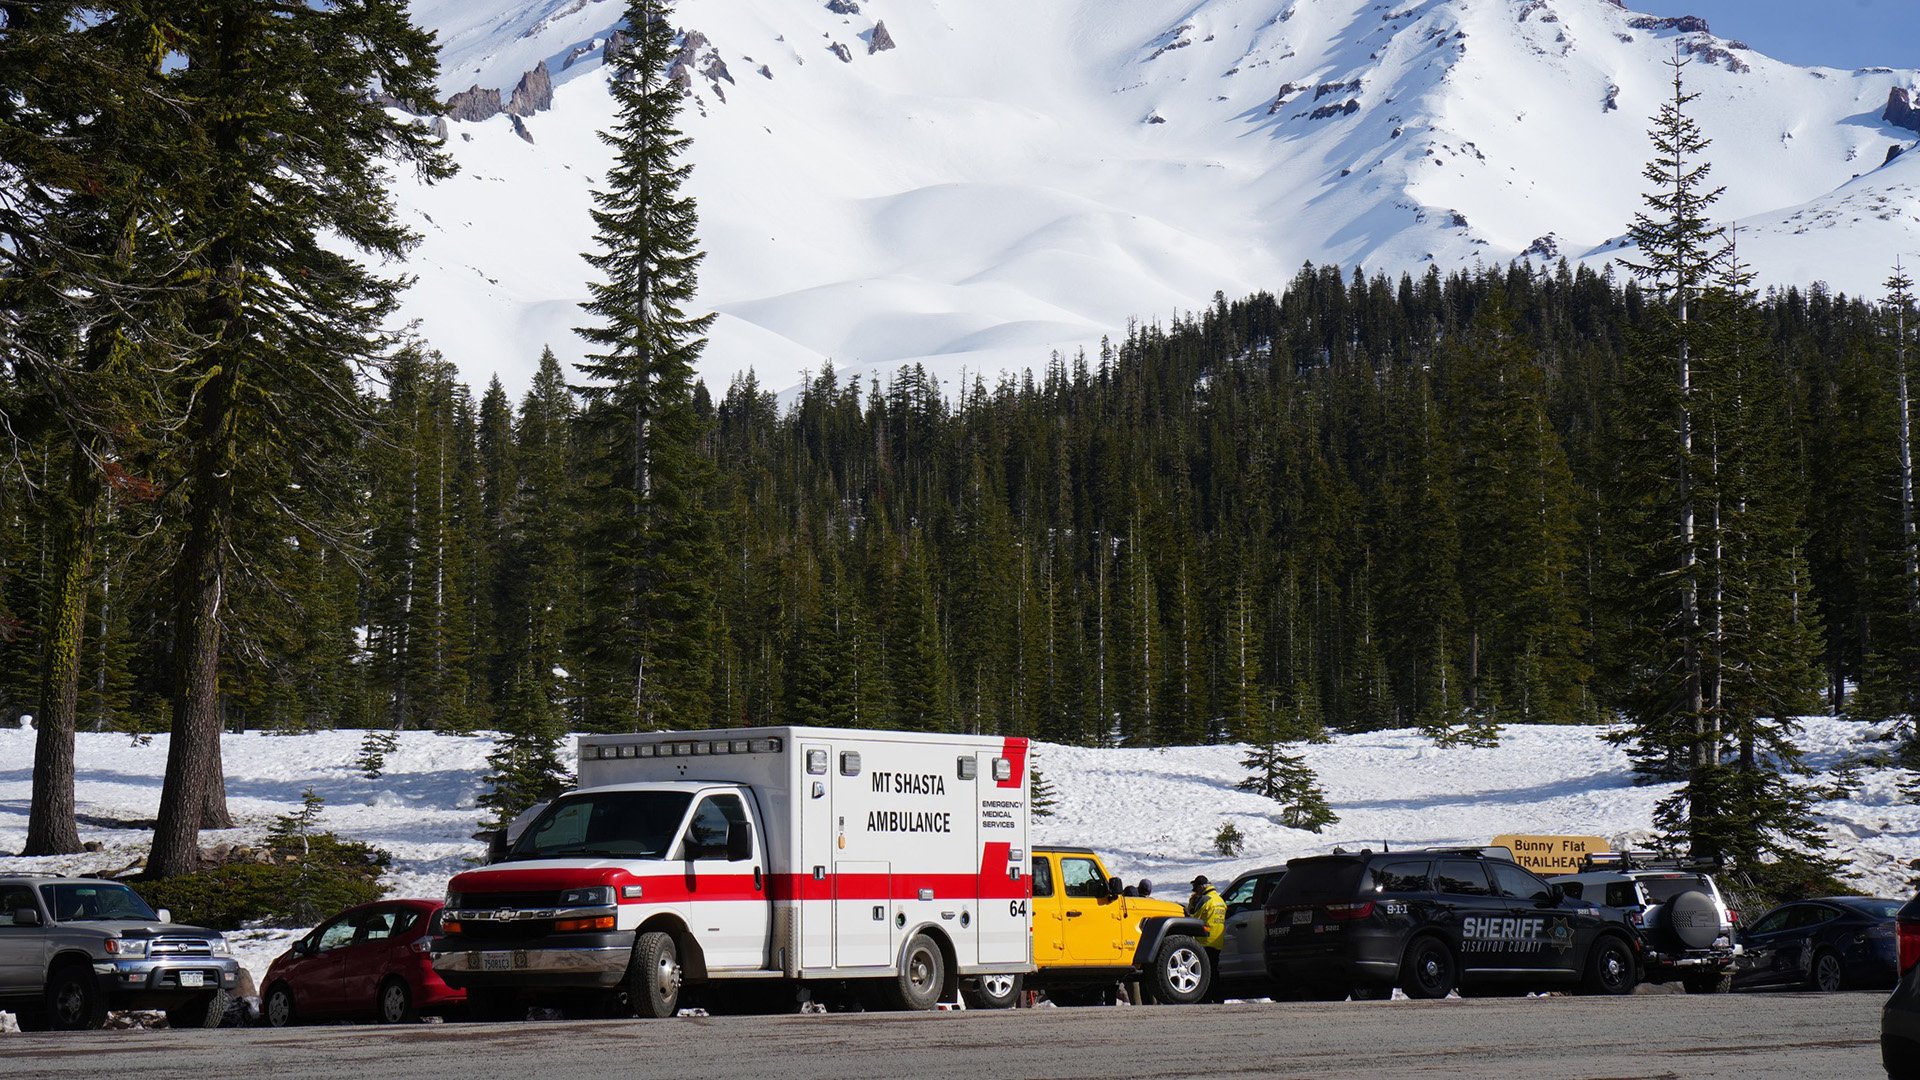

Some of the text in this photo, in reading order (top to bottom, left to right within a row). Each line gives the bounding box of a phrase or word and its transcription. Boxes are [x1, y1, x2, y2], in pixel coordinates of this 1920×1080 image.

[872, 772, 945, 795] MT SHASTA
[982, 801, 1024, 809] EMERGENCY
[867, 811, 951, 833] AMBULANCE
[982, 821, 1015, 829] SERVICES
[1514, 840, 1586, 854] Bunny Flat
[1009, 900, 1026, 917] 64
[1268, 926, 1291, 936] SHERIFF
[1462, 917, 1544, 939] SHERIFF
[1461, 940, 1543, 953] SISKIYOU COUNTY
